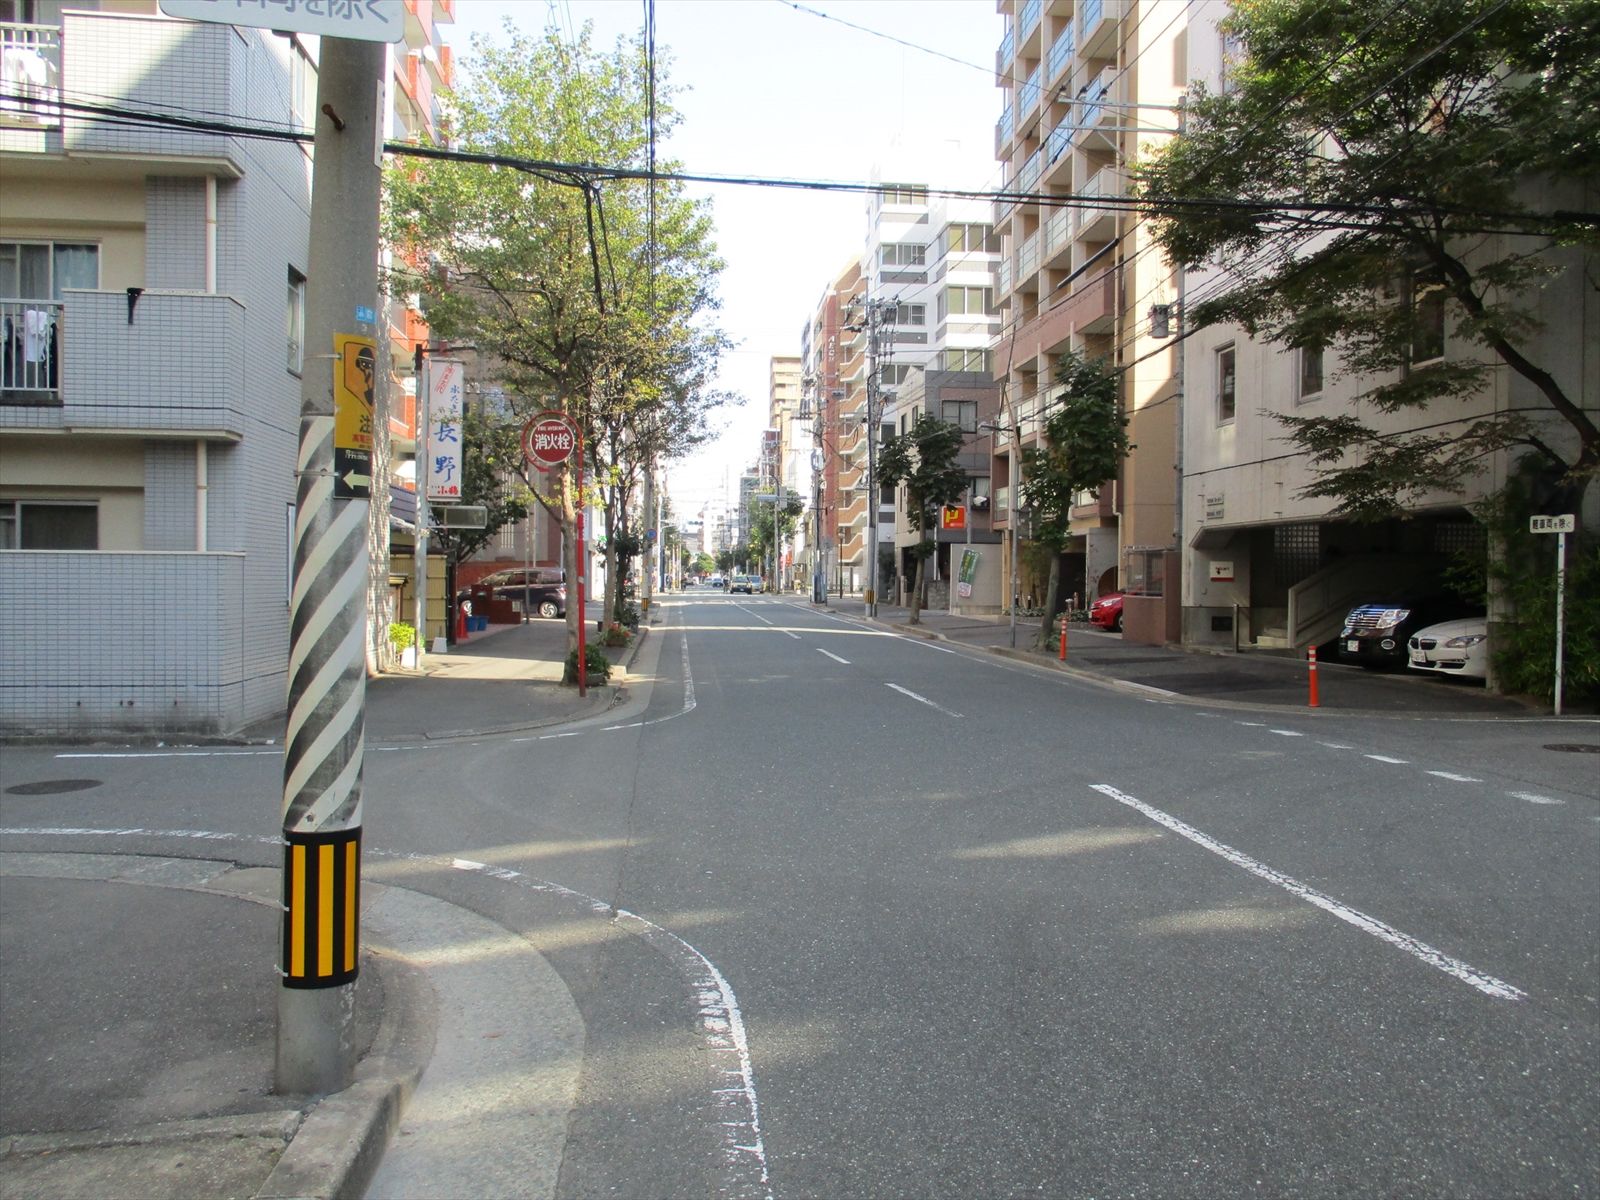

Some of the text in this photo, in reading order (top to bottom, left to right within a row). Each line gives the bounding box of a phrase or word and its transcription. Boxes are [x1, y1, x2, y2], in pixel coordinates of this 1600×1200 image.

[434, 423, 458, 483] 長野
[534, 433, 571, 450] 消火栓
